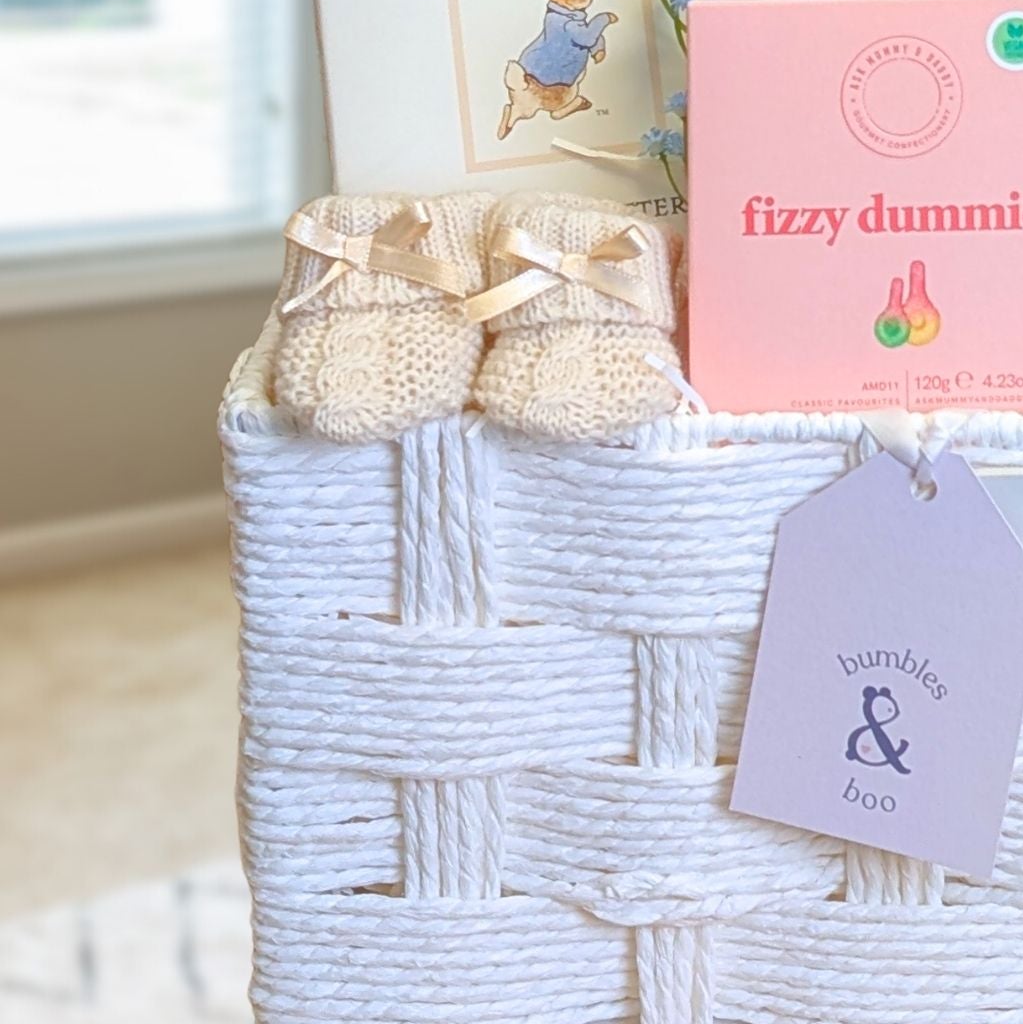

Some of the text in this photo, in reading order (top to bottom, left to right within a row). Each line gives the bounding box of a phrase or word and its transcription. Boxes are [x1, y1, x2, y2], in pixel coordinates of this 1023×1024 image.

[853, 109, 951, 149] GOURMET CONFECTIONERY
[742, 195, 850, 246] fizzy
[791, 397, 901, 408] CLASSIC FAVOURITES
[915, 375, 950, 393] 120g
[837, 649, 948, 701] bumbles
[845, 685, 911, 775] &
[842, 777, 896, 813] boo
